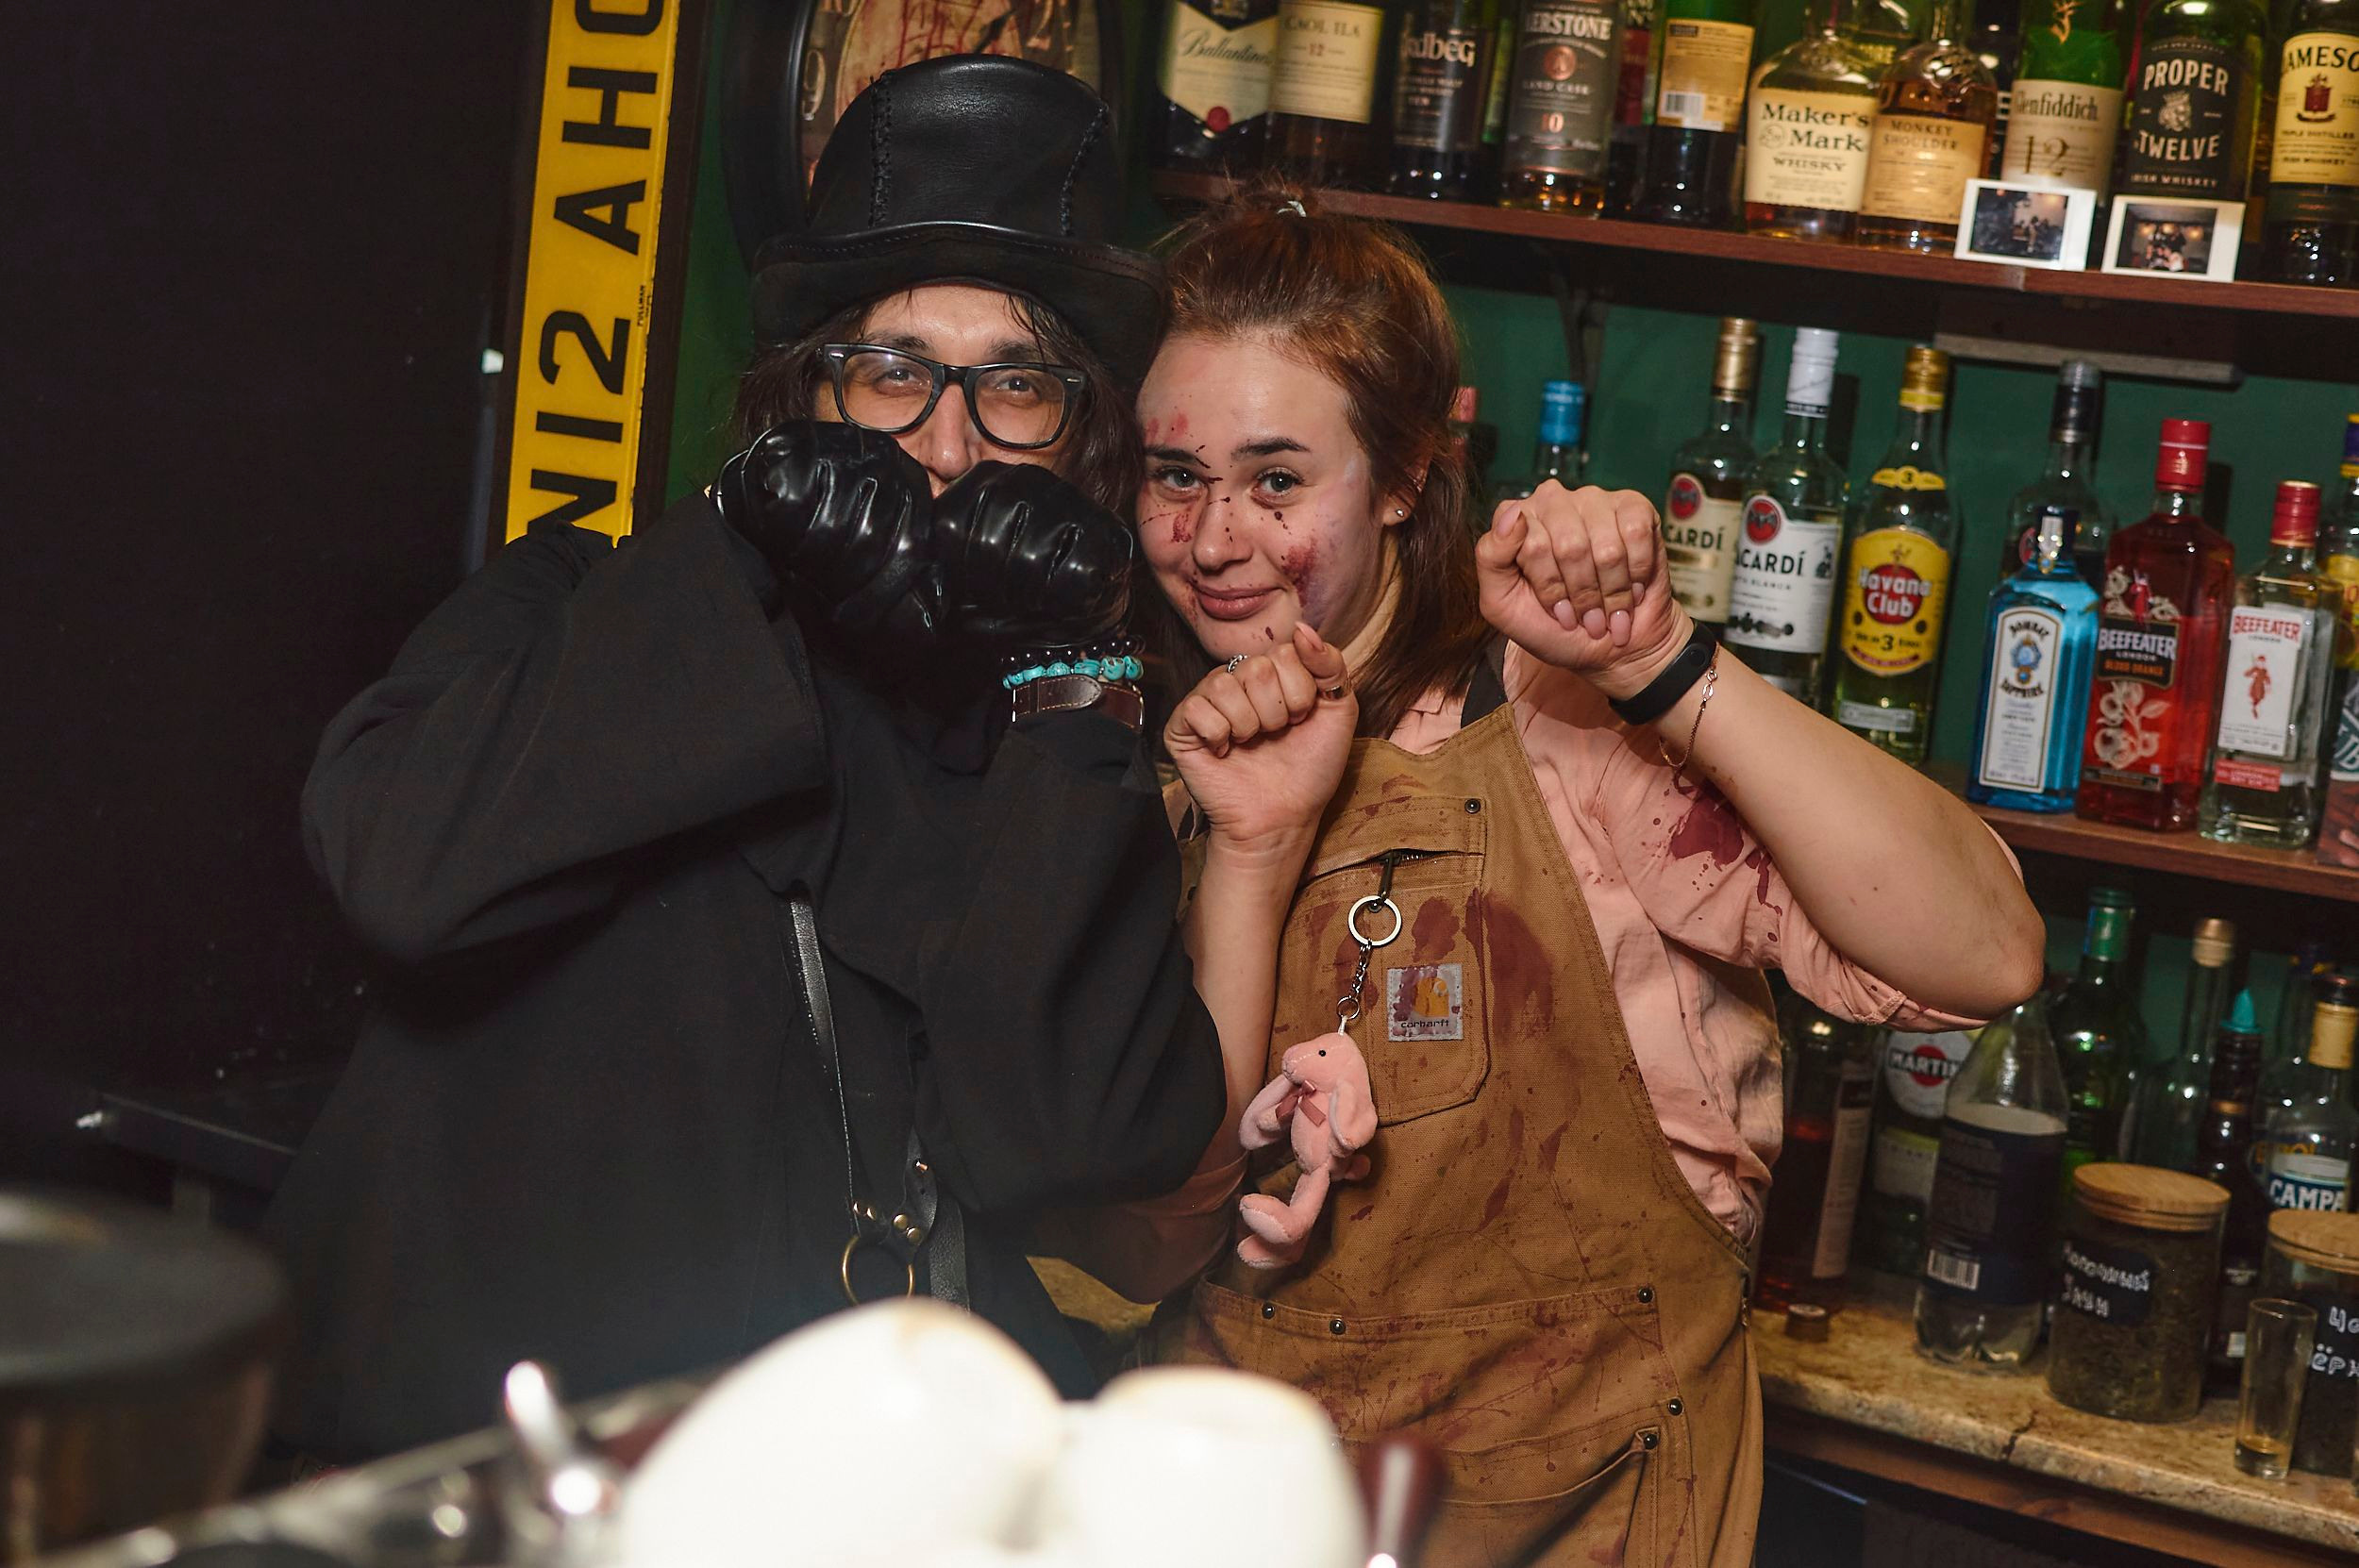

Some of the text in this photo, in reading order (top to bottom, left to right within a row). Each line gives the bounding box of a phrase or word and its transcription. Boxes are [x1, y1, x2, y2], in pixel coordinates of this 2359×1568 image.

[2283, 46, 2359, 73] AMESO
[2143, 58, 2229, 96] PROPER
[1762, 103, 1870, 127] Maker's
[1890, 120, 1953, 137] MONKEY
[1789, 129, 1865, 152] Mark
[1883, 133, 1959, 151] SHOULDER
[2138, 129, 2221, 162] TWELVE
[1773, 157, 1846, 172] WHISKY
[2023, 136, 2070, 176] 12
[1735, 548, 1807, 576] CARDÍ
[1859, 567, 1932, 596] Havana
[1866, 592, 1915, 619] Club
[2231, 614, 2300, 643] BEEFEATER
[2098, 628, 2177, 661] BEEFEATER
[1400, 1019, 1449, 1028] carhartt
